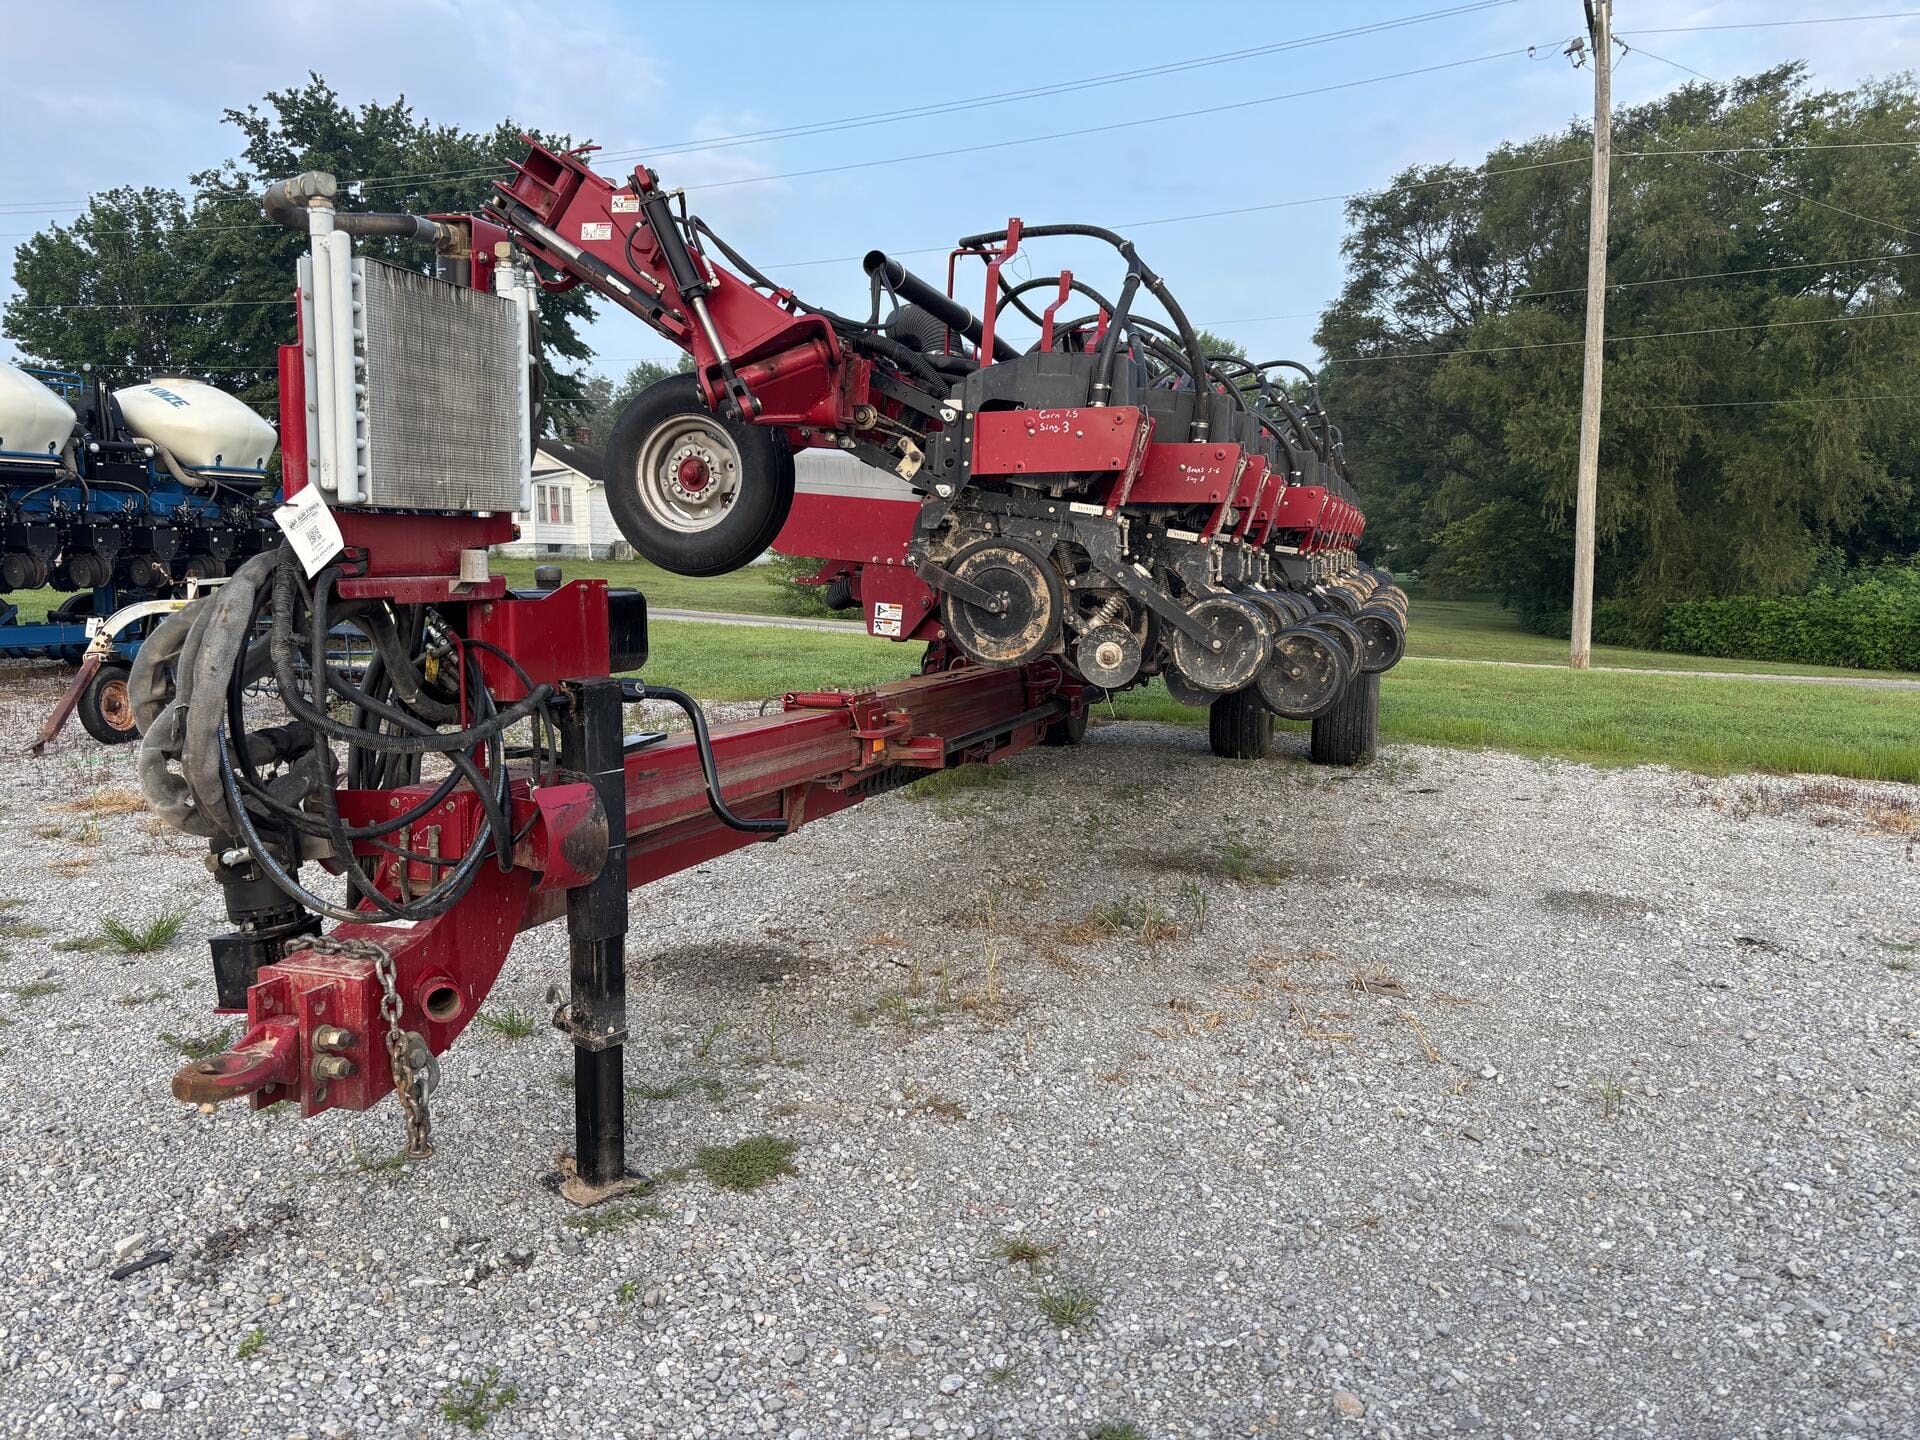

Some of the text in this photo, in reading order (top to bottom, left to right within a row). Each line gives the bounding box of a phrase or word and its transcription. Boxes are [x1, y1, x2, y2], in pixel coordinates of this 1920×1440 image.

[144, 386, 191, 408] KINZE
[1039, 410, 1060, 419] Corn
[1062, 421, 1069, 433] 3
